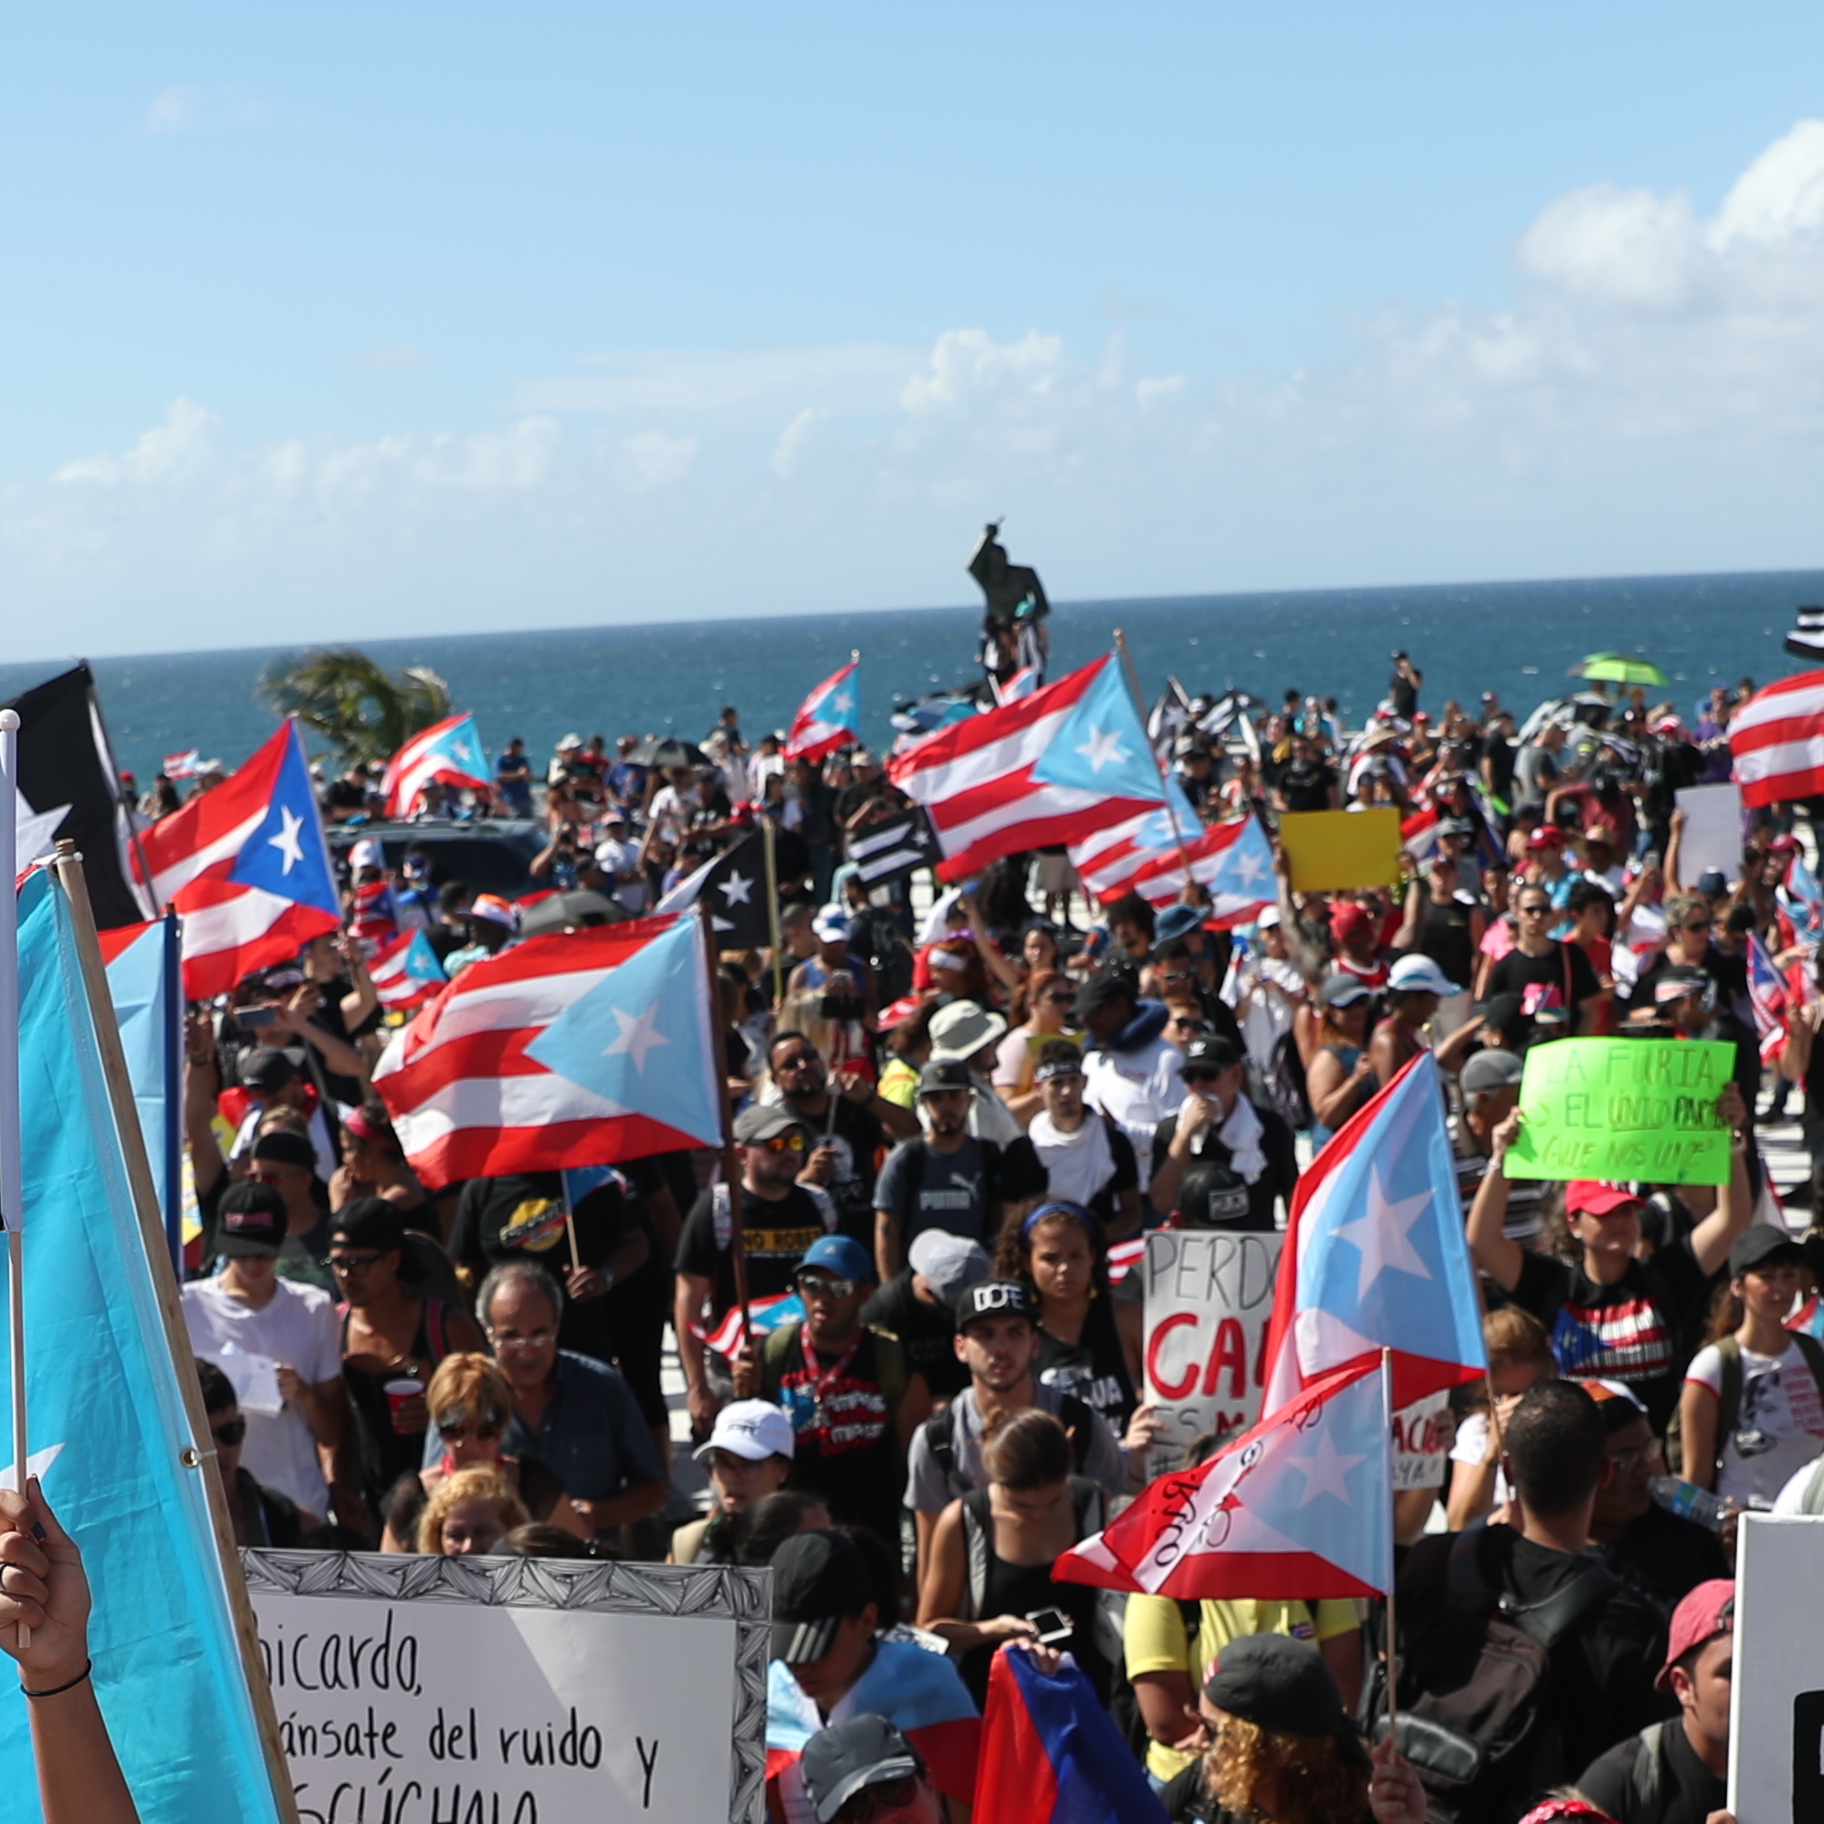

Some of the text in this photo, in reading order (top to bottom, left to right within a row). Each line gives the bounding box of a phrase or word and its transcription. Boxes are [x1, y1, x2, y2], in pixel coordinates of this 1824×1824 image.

[1605, 1048, 1715, 1089] FURIA
[1565, 1092, 1603, 1129] EL
[1147, 1232, 1284, 1312] PERD
[279, 1705, 660, 1810] ánsate del ruido y
